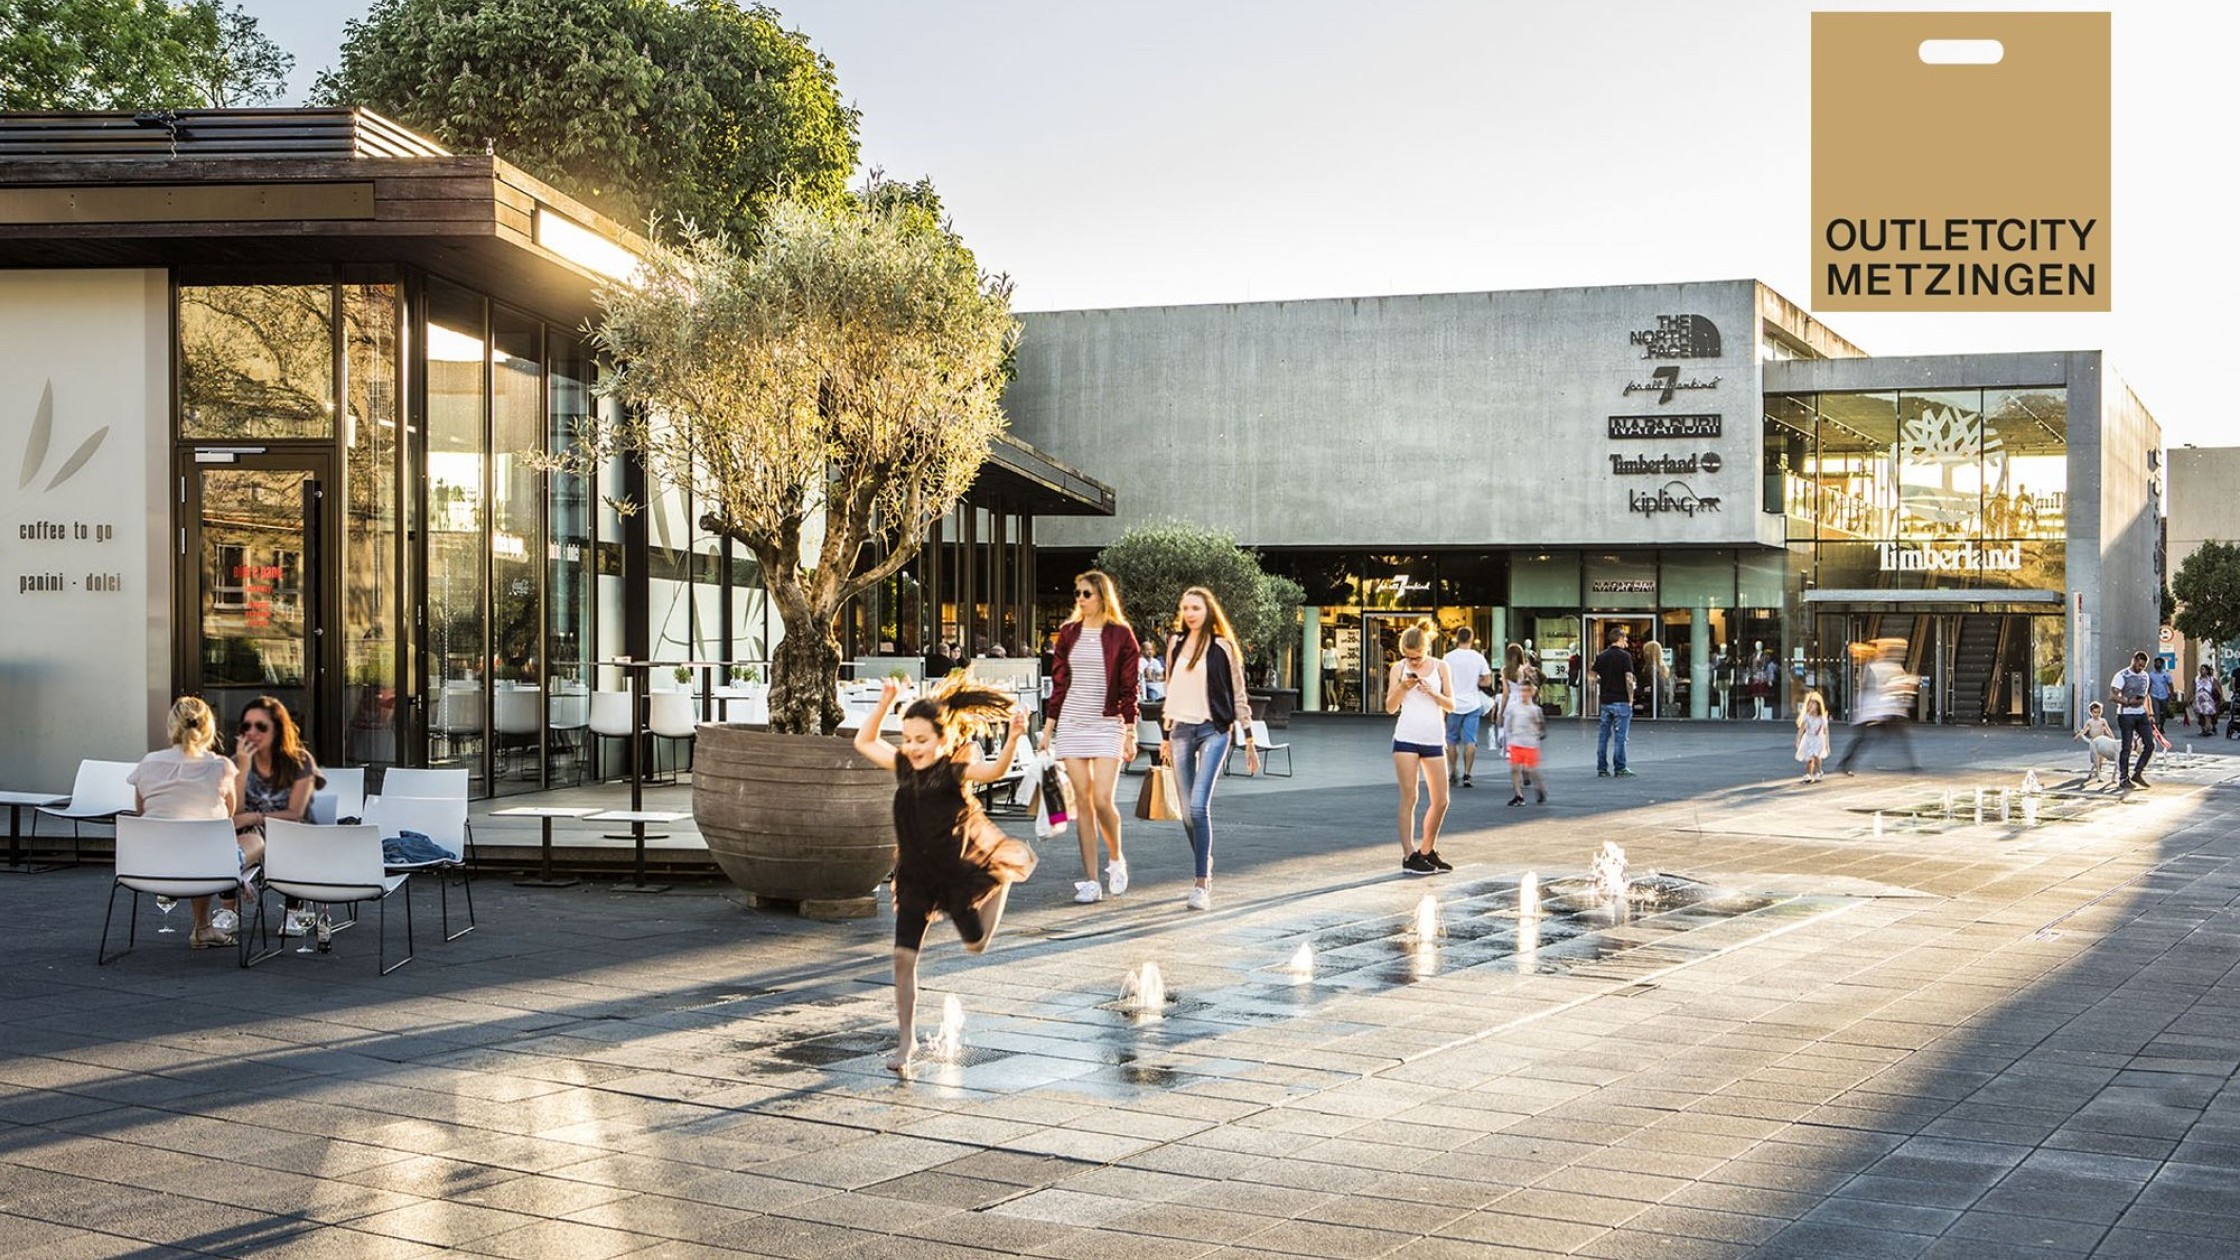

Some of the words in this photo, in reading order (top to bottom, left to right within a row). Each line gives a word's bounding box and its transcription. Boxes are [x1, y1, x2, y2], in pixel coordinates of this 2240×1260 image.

[1656, 314, 1690, 329] THE
[1630, 329, 1690, 345] NORTH
[1646, 344, 1690, 359] FACE
[1652, 366, 1680, 405] 7
[1611, 416, 1720, 435] NAPAPIJRI
[1609, 453, 1699, 475] Timberland
[1629, 488, 1695, 518] kipling
[19, 521, 66, 540] coffee
[74, 521, 88, 540] to
[96, 524, 113, 543] go
[1873, 540, 2022, 571] Timberland
[19, 573, 64, 594] panini
[86, 573, 122, 592] dolci
